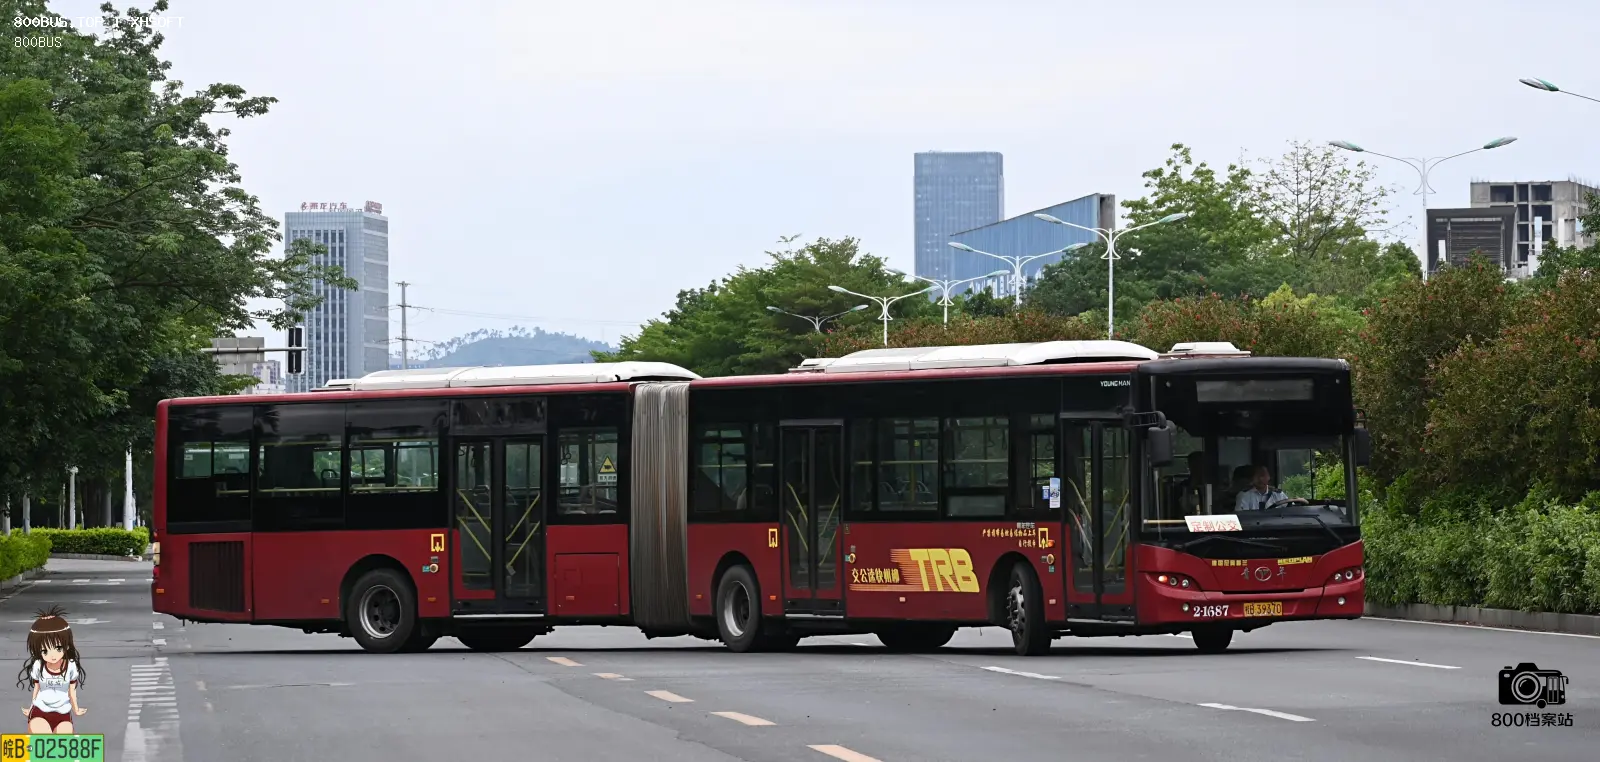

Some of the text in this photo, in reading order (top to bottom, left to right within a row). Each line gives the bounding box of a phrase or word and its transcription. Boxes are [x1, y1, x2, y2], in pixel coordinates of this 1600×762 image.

[1191, 520, 1238, 532] 定制公交
[908, 548, 980, 592] TRB
